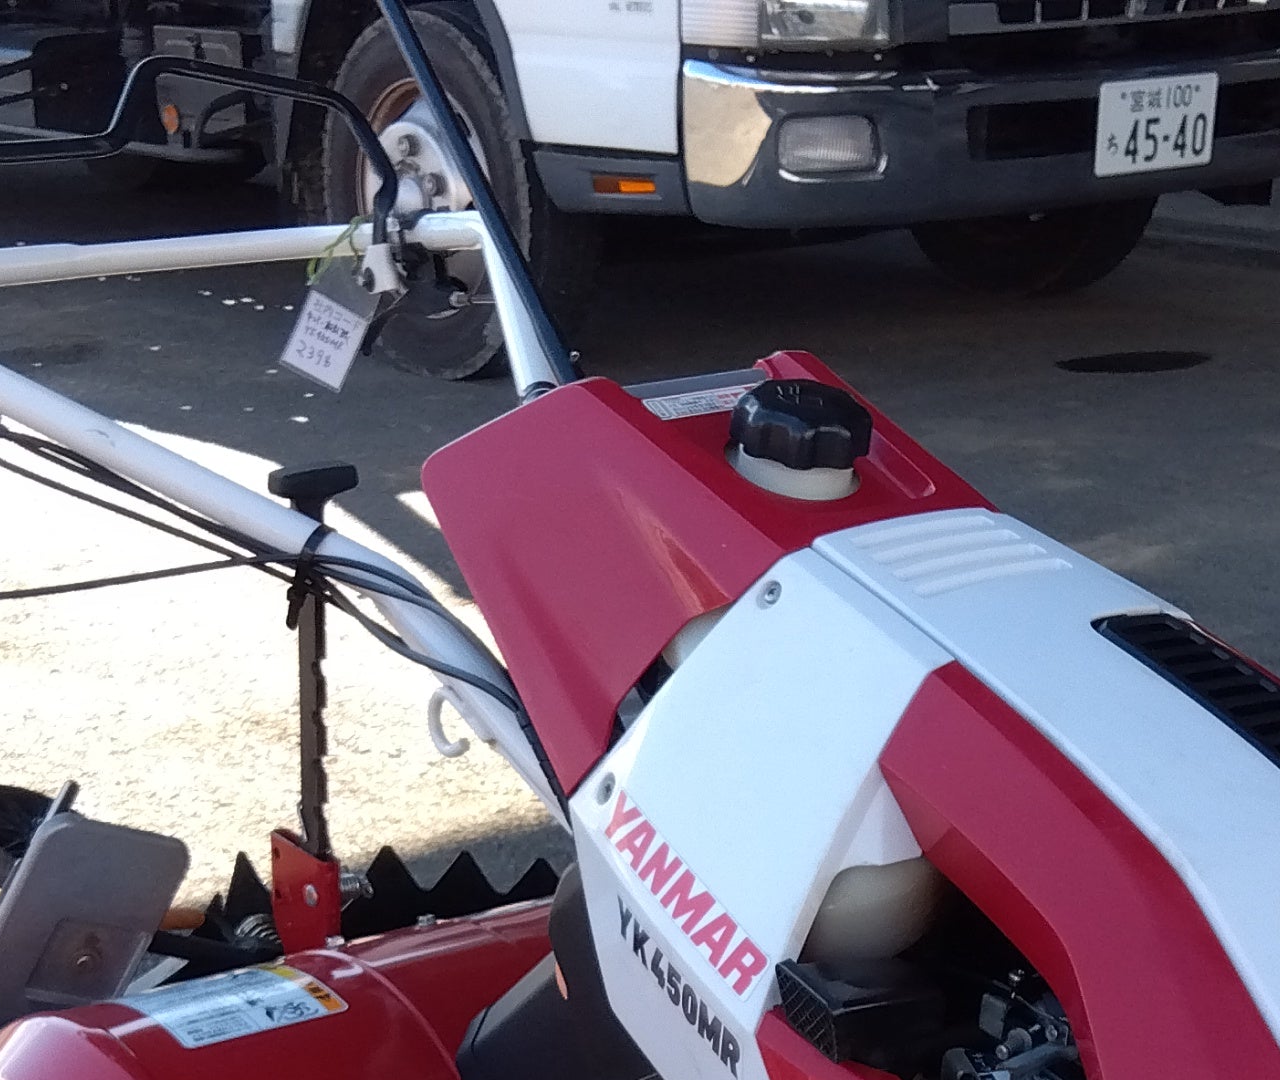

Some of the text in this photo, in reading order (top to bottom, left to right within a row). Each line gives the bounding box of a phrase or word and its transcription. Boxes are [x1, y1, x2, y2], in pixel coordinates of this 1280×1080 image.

[1124, 112, 1207, 164] 45-40
[604, 789, 769, 996] YANMAR
[617, 894, 741, 1080] YK450MR
